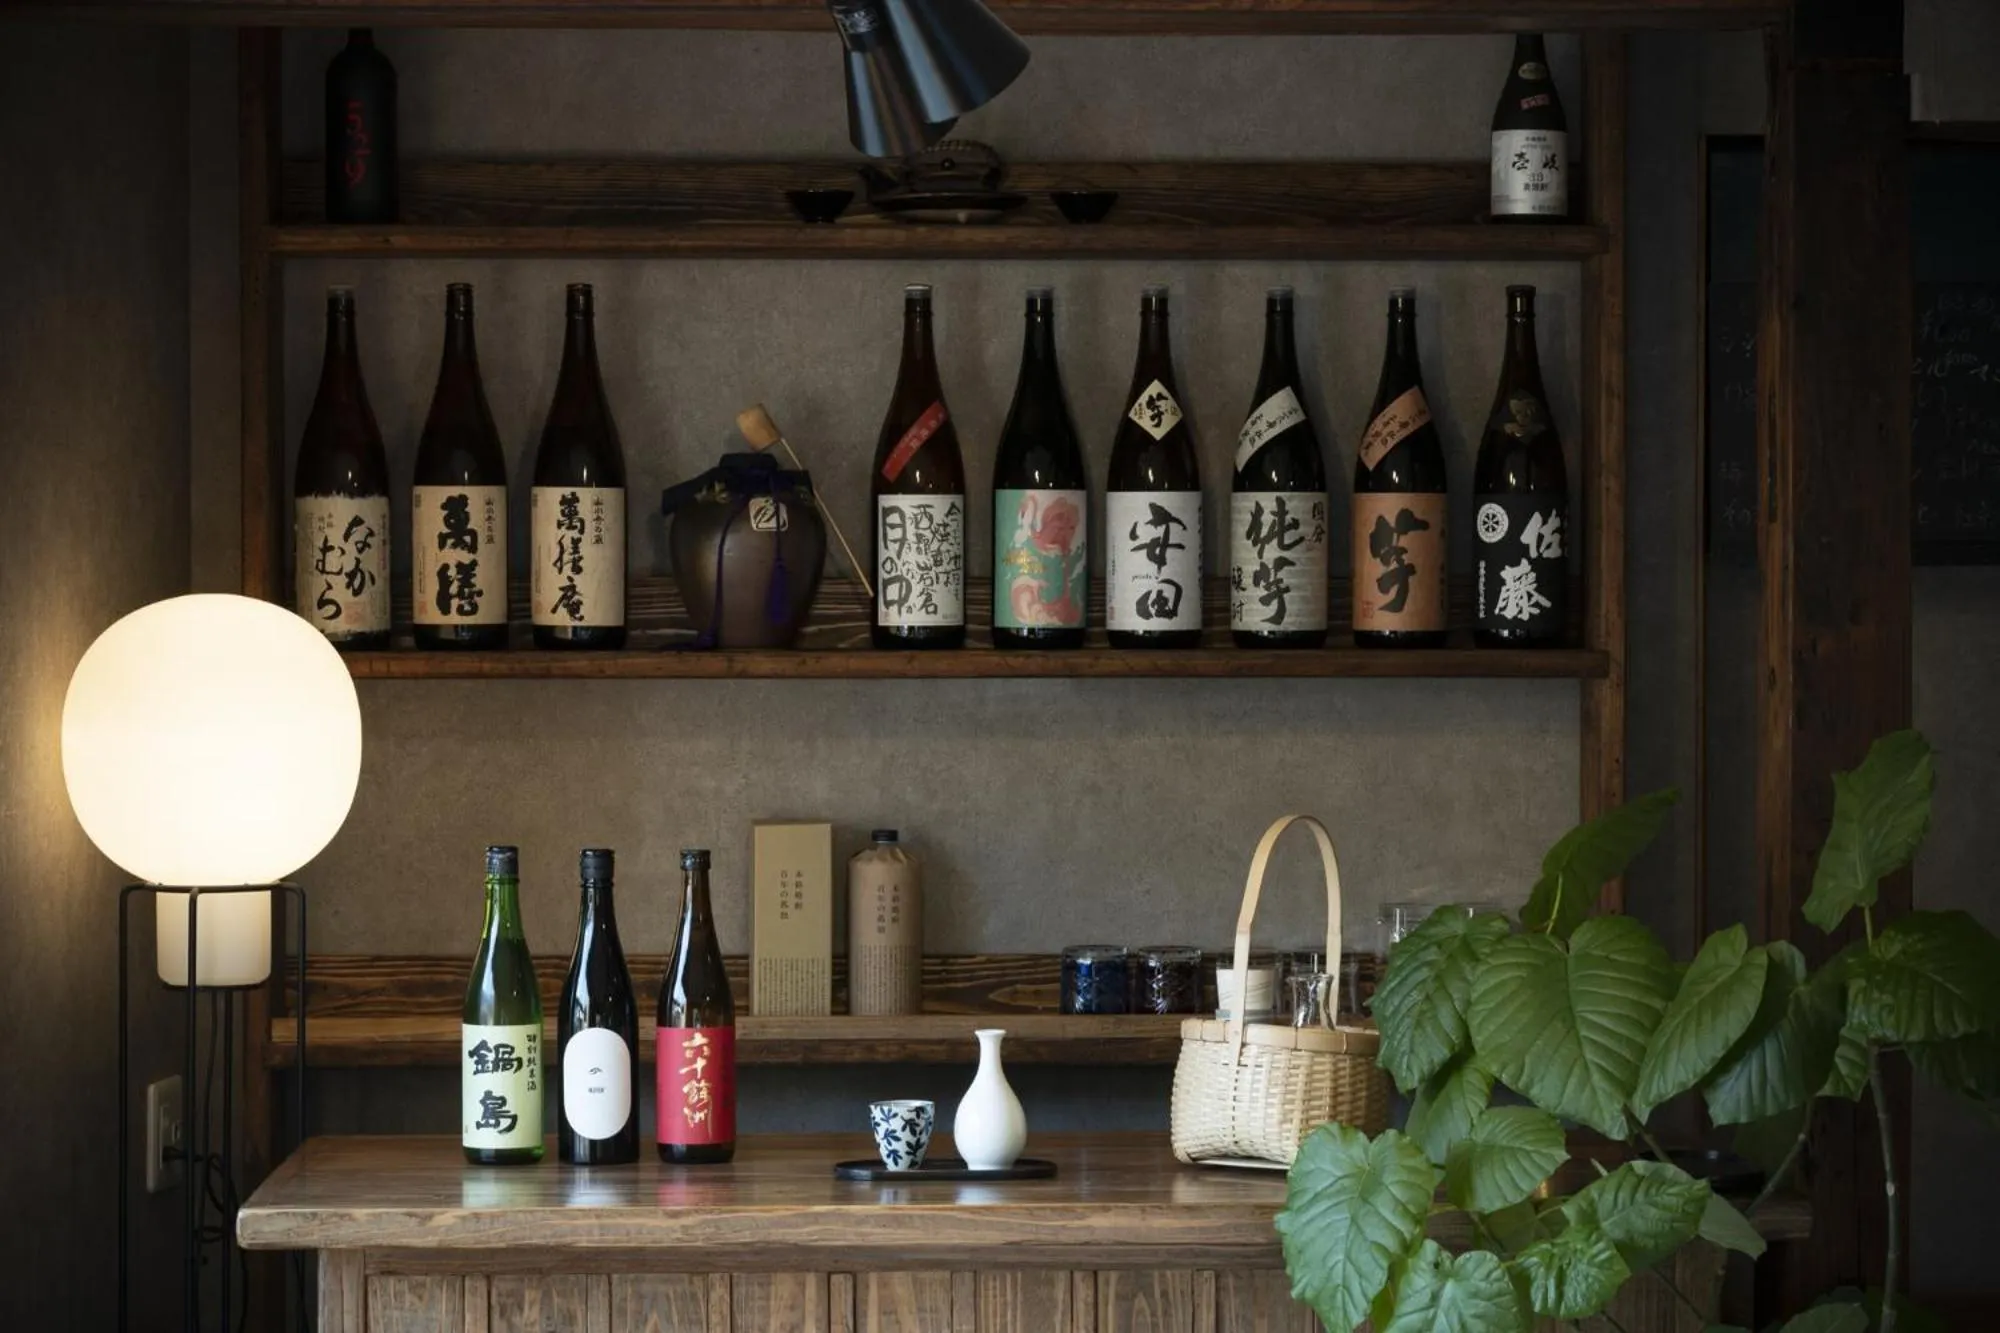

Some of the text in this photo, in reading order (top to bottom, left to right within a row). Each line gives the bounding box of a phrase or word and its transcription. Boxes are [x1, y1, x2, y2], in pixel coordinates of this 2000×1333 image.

[315, 535, 346, 621] むら
[344, 515, 376, 598] なか
[436, 493, 484, 616] 萬膳
[550, 491, 585, 622] 萬膳庵
[1129, 501, 1188, 621] 安田
[1494, 507, 1563, 623] 佐藤
[467, 1039, 525, 1135] 鍋島
